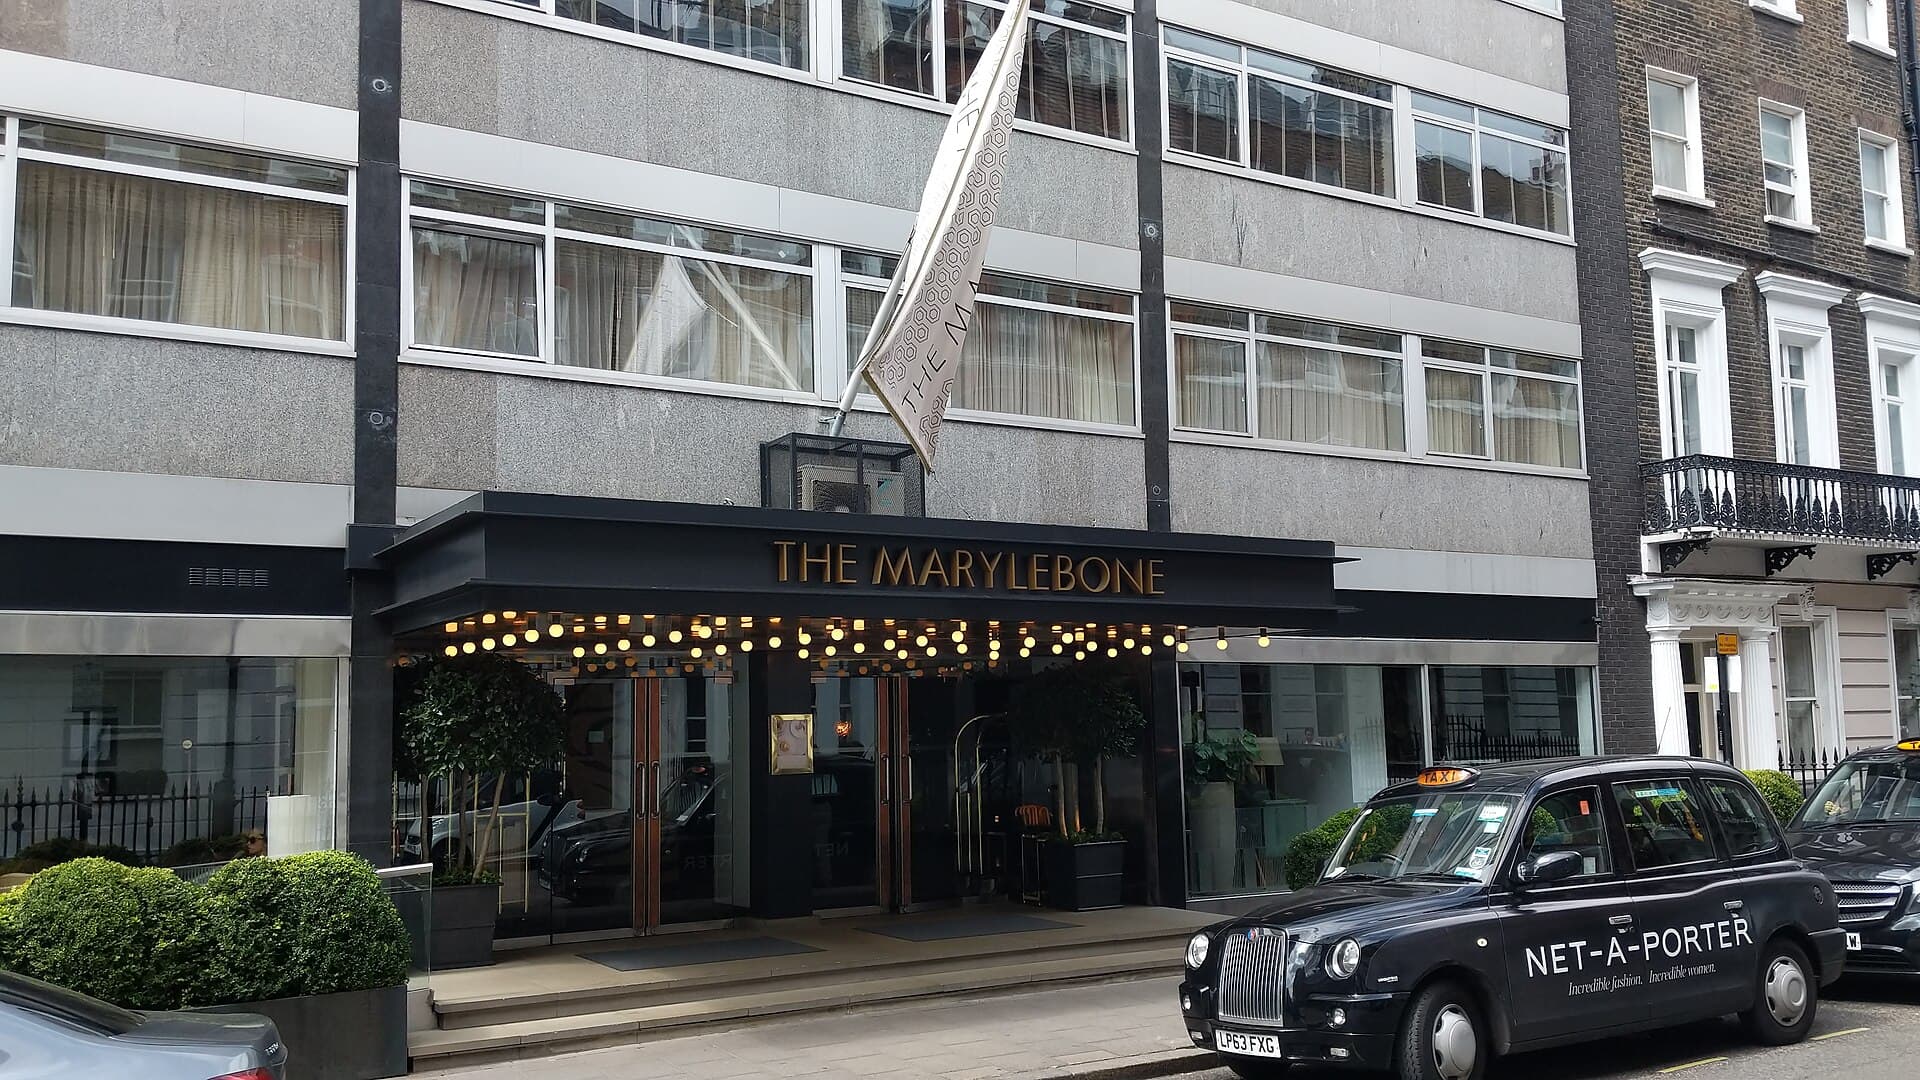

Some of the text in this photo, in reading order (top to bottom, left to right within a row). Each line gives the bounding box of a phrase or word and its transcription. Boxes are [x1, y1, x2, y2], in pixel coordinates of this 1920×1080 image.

[901, 344, 946, 413] THE
[773, 541, 1165, 595] THE MARYLEBONE
[1425, 770, 1456, 783] TAXI
[1525, 918, 1753, 978] NET-A-PORTER
[1568, 963, 1717, 996] Incredible fashion. Incredible women.
[1219, 1031, 1274, 1053] LP63 FXG
